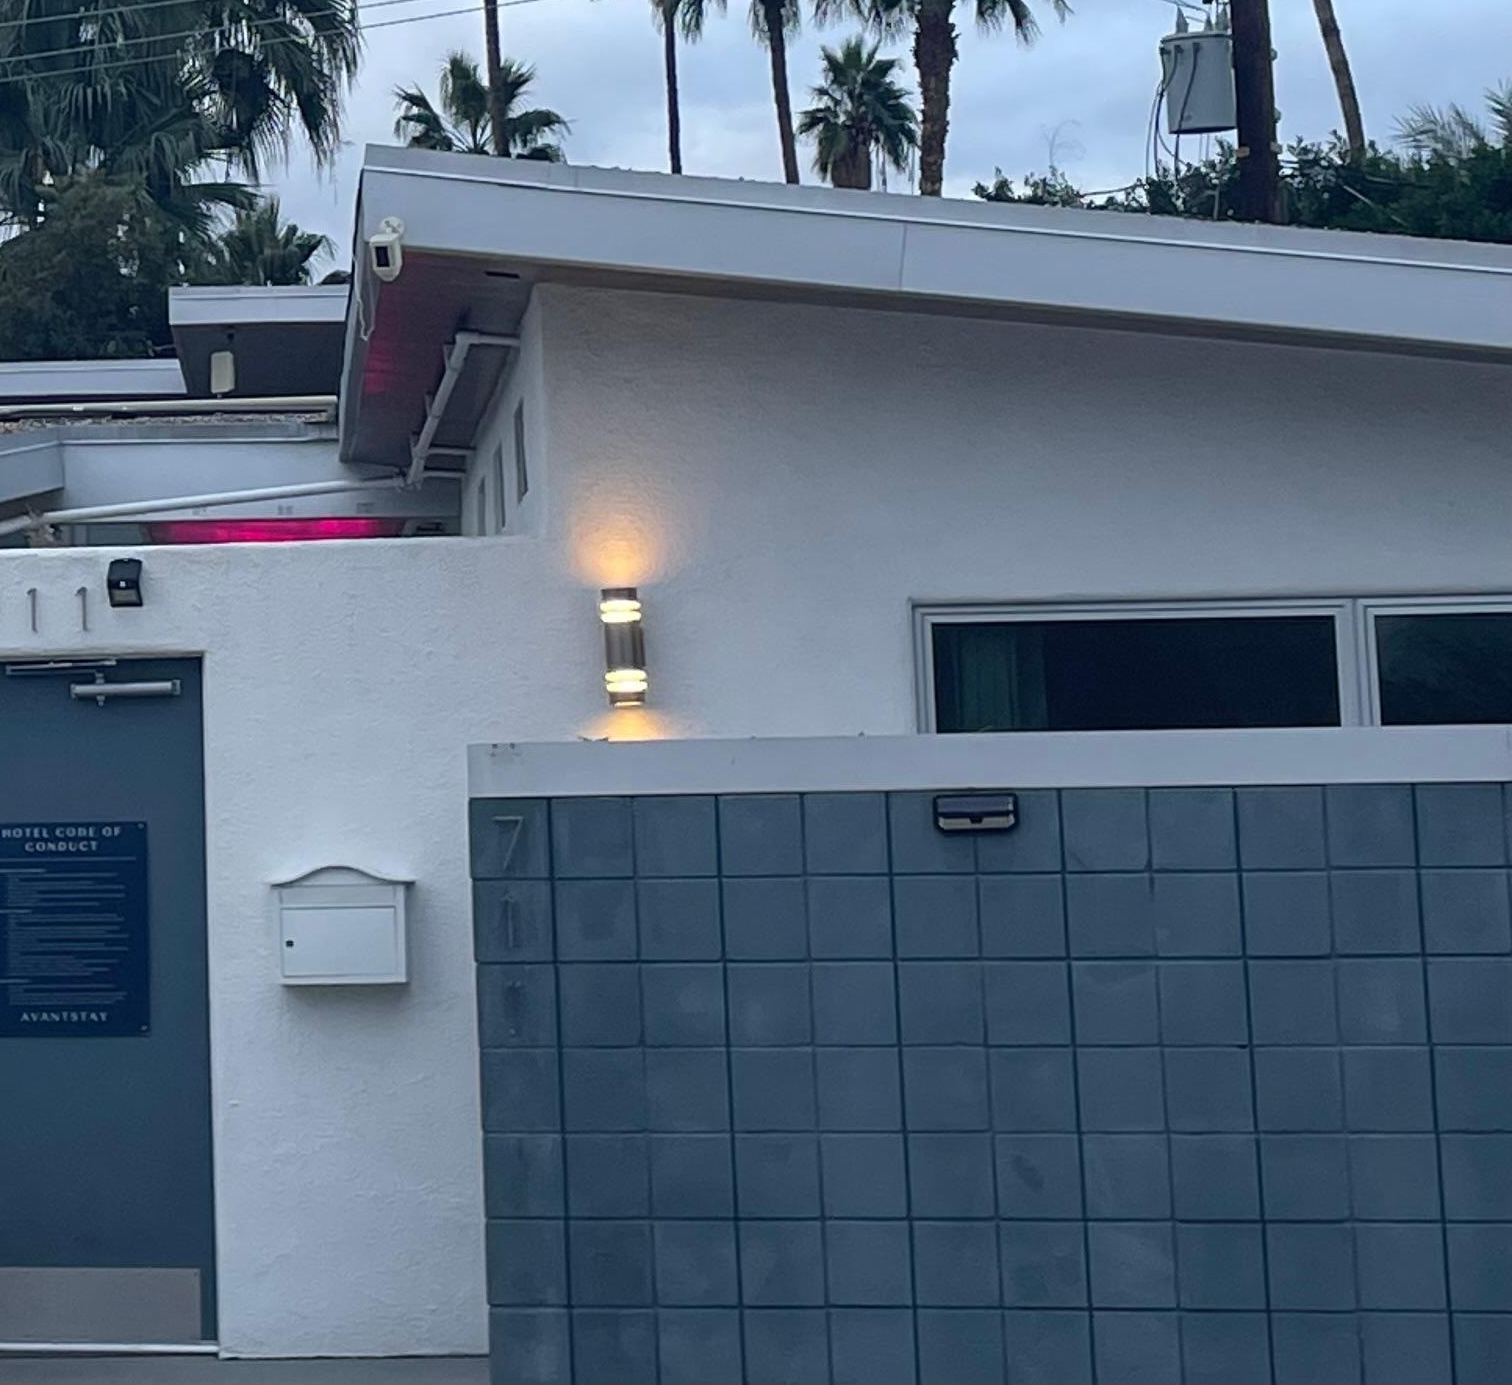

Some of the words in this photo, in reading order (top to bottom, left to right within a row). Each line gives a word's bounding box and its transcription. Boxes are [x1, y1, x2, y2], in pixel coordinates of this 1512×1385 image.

[1, 827, 49, 838] HOTEL
[55, 827, 96, 838] CODE
[102, 826, 121, 837] OF
[24, 841, 99, 852] CONDUCT
[19, 1011, 109, 1022] AVANTSTAY
